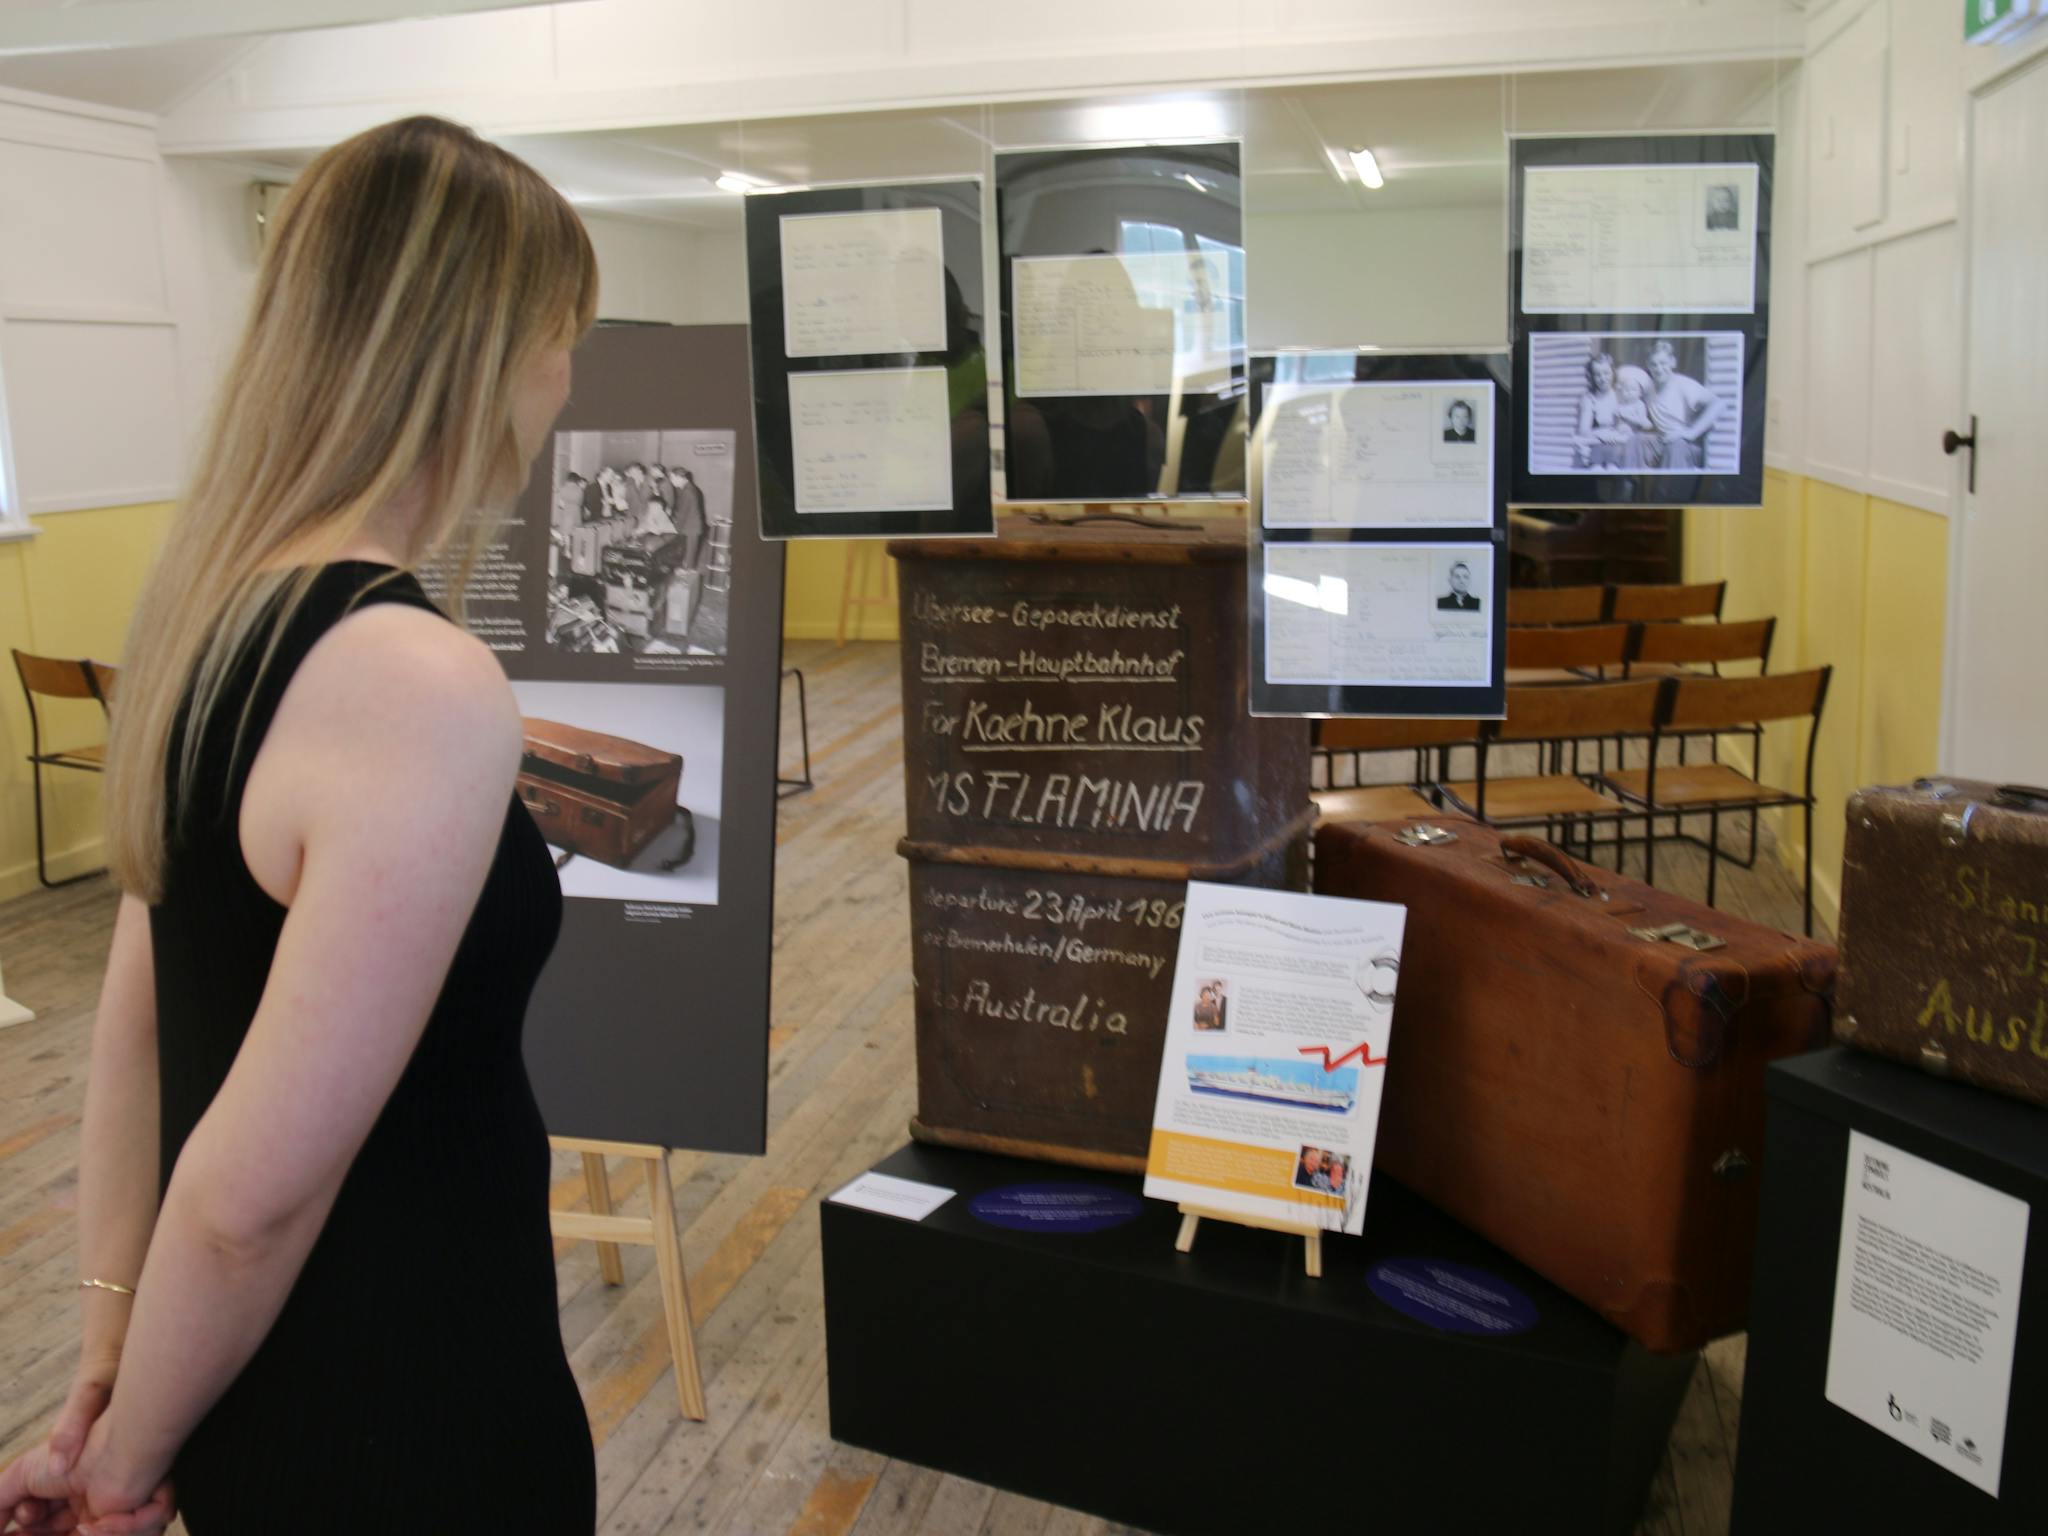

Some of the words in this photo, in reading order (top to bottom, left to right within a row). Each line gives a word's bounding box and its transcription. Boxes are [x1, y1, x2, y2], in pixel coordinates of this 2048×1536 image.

[962, 697, 1090, 743] Kaehne
[1096, 702, 1206, 746] Klaus
[981, 770, 1206, 834] FLAMINIA
[1022, 888, 1065, 925] 23
[1066, 894, 1123, 931] April
[963, 979, 1129, 1036] Australia
